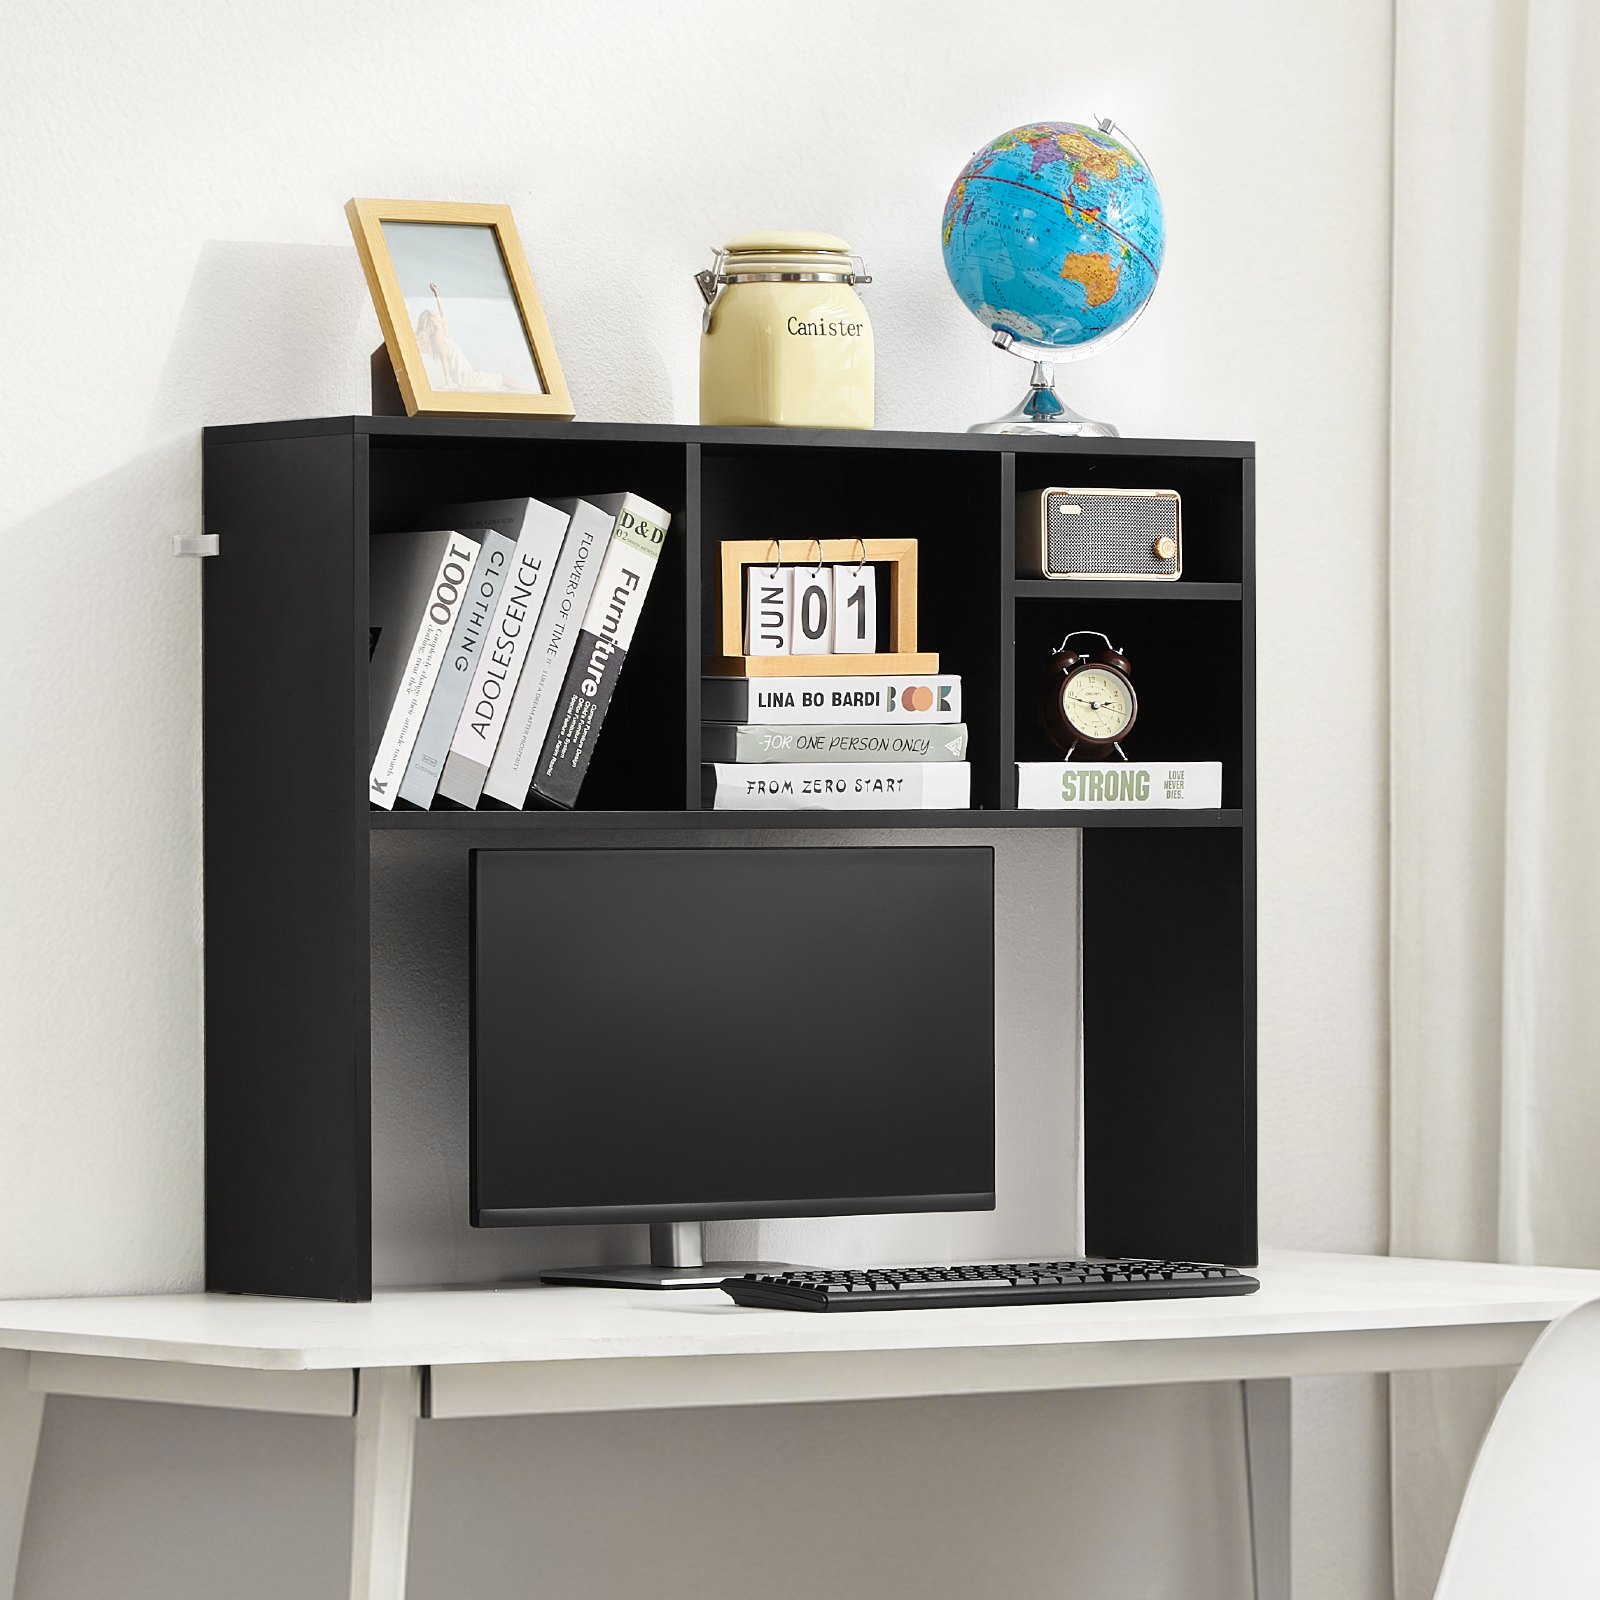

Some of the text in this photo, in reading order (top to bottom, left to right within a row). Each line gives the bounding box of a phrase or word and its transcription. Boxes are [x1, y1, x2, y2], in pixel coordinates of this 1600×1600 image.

[987, 220, 1012, 230] INDIAN
[787, 316, 863, 337] Canister
[430, 544, 471, 625] 1000
[546, 532, 594, 657] FLOWERS OF TIME
[454, 551, 505, 672] CLOTHING
[761, 586, 784, 649] JUN
[581, 568, 640, 697] Furniture
[470, 553, 542, 740] ADOLESCENCE
[406, 676, 415, 695] their
[387, 628, 443, 777] Completely change their attitude towards
[530, 692, 541, 715] DREAM
[567, 694, 578, 715] Special
[758, 691, 880, 708] LINA BO BARDI
[525, 715, 534, 735] AFTER
[560, 714, 571, 735] Feature
[560, 697, 584, 759] Office Furniture System
[573, 719, 584, 743] Furniture
[571, 704, 597, 768] Current Furniture Design
[796, 735, 826, 750] ONE
[828, 736, 890, 752] PERSON
[553, 739, 562, 757] Karim
[546, 756, 557, 776] Rashid
[1168, 770, 1185, 780] LOVE
[746, 778, 904, 795] FROM ZERO START
[1061, 770, 1150, 801] STRONG
[1163, 780, 1185, 790] NEVER
[1166, 790, 1184, 800] DIES.
